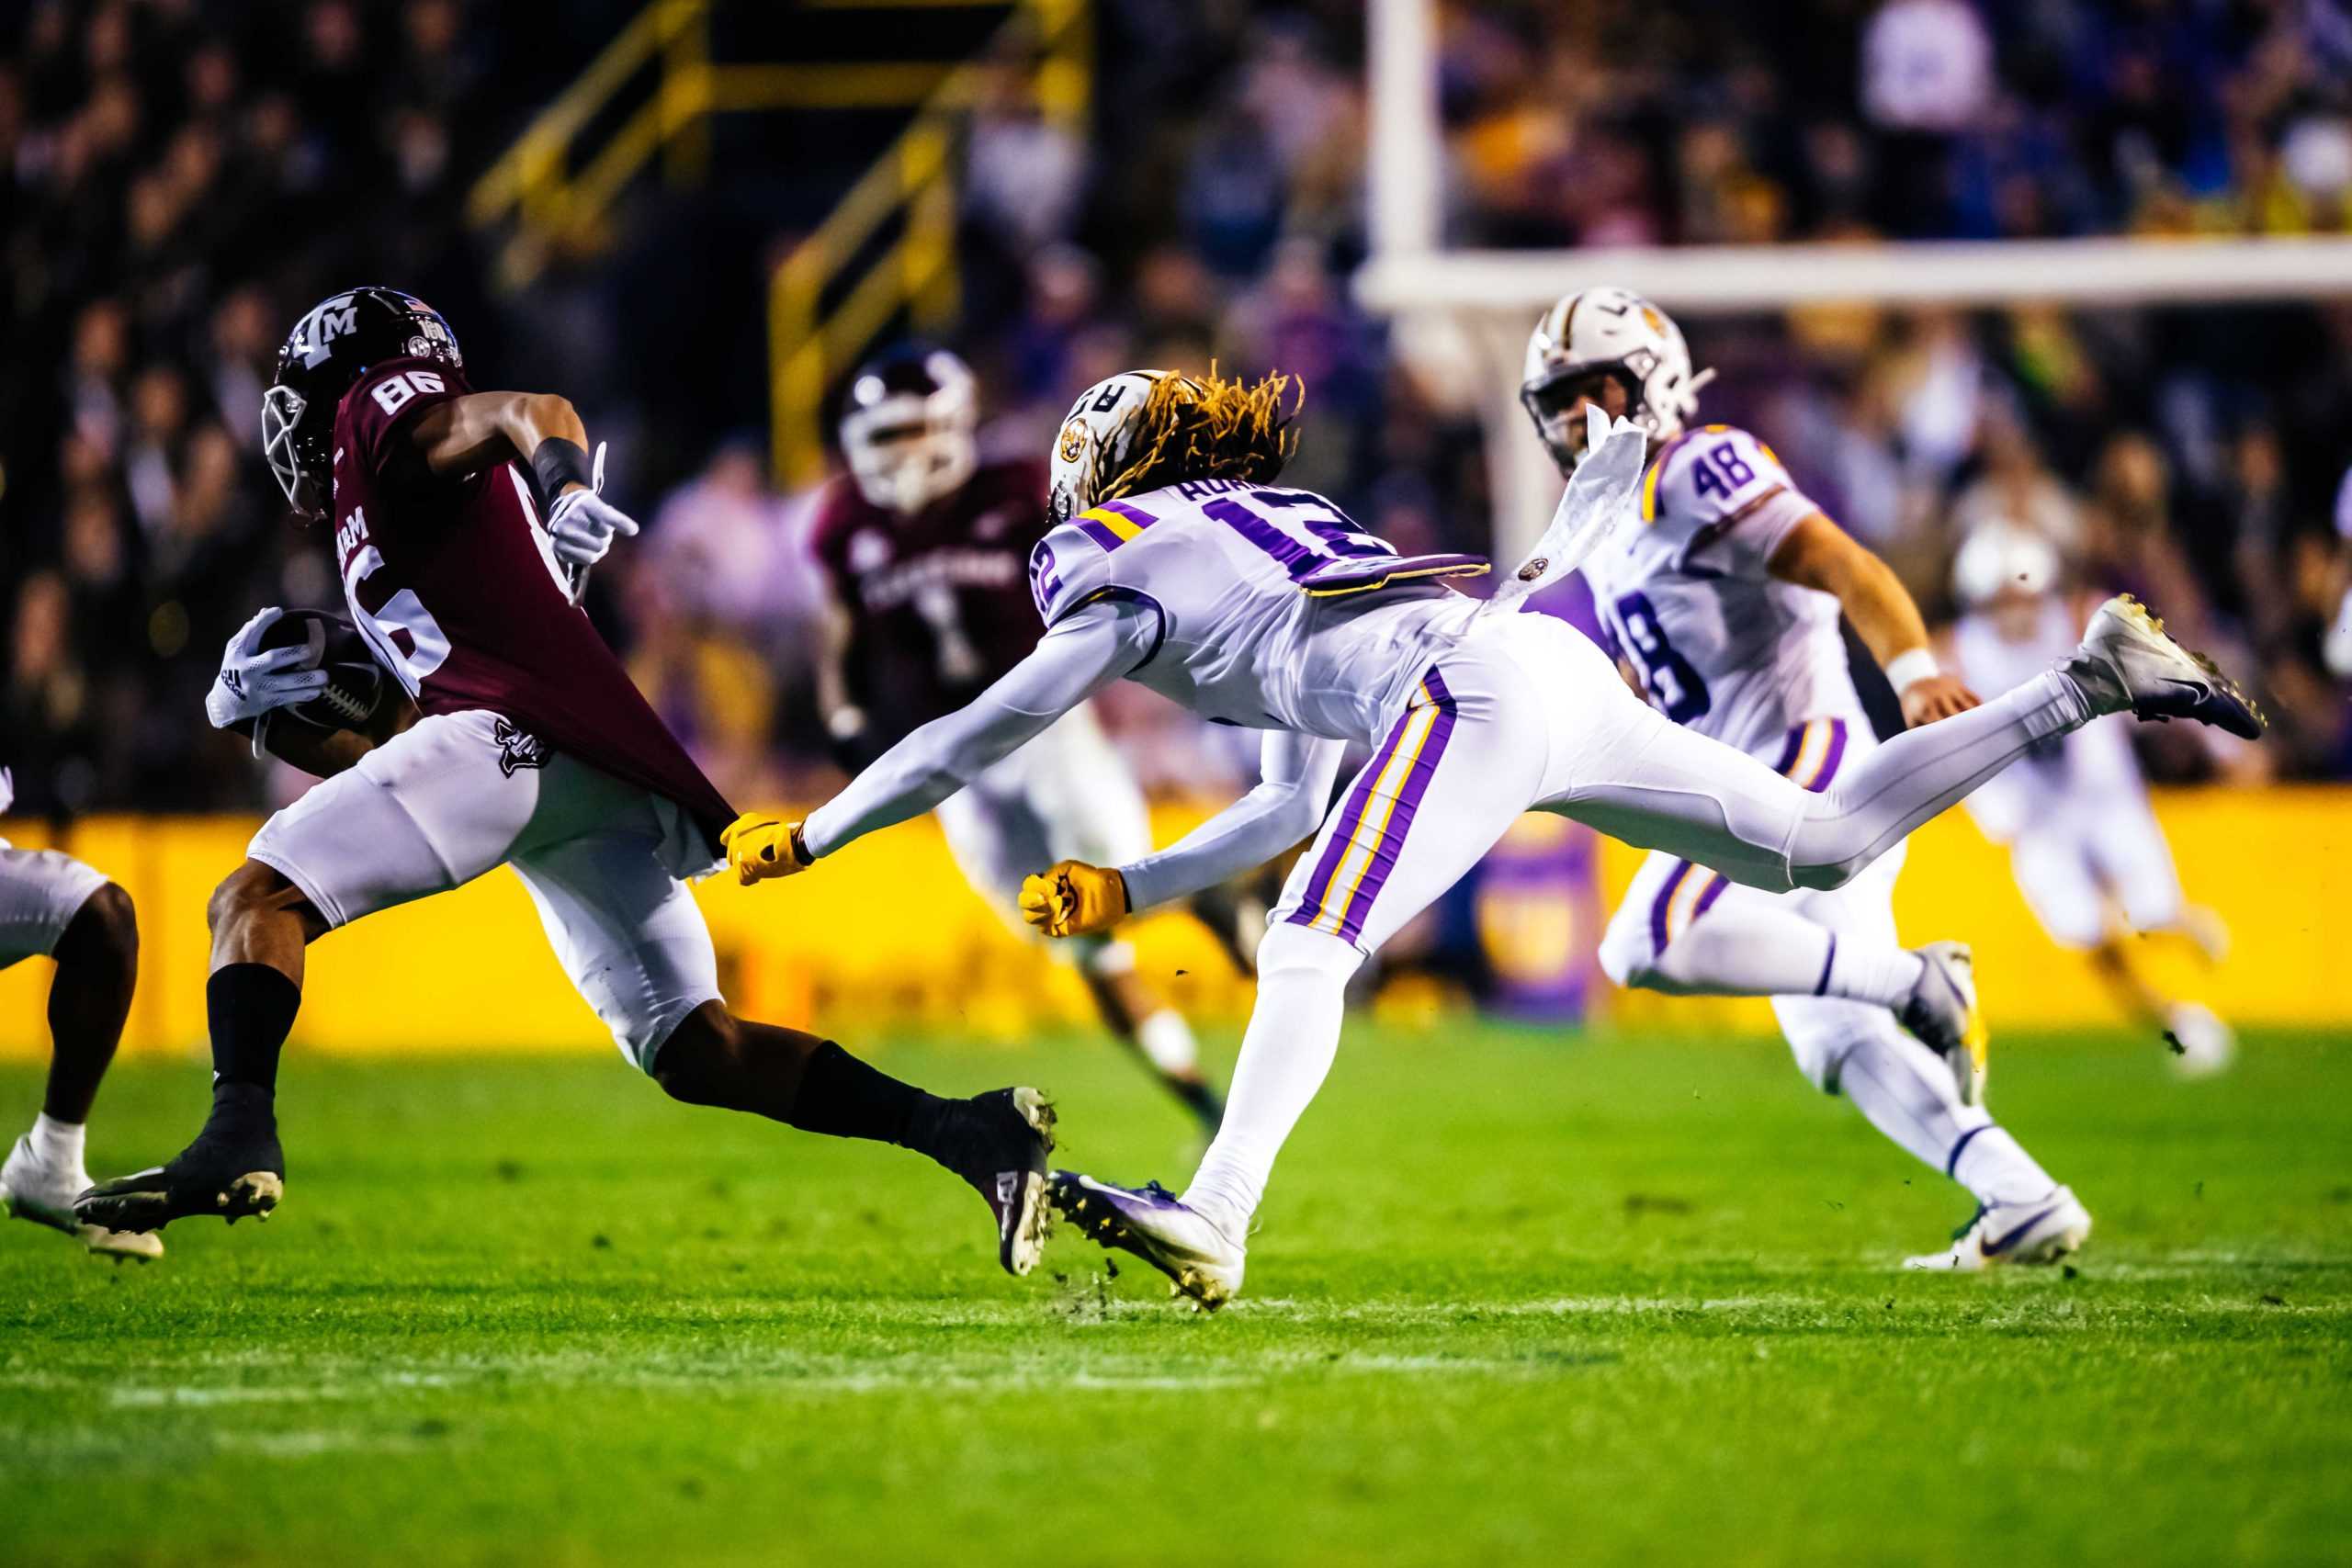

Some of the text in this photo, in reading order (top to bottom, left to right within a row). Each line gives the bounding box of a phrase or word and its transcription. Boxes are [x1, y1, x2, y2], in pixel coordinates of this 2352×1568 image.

[371, 370, 446, 416] 86
[1690, 440, 1756, 501] 48
[344, 544, 452, 698] 6
[1607, 590, 1712, 726] 8
